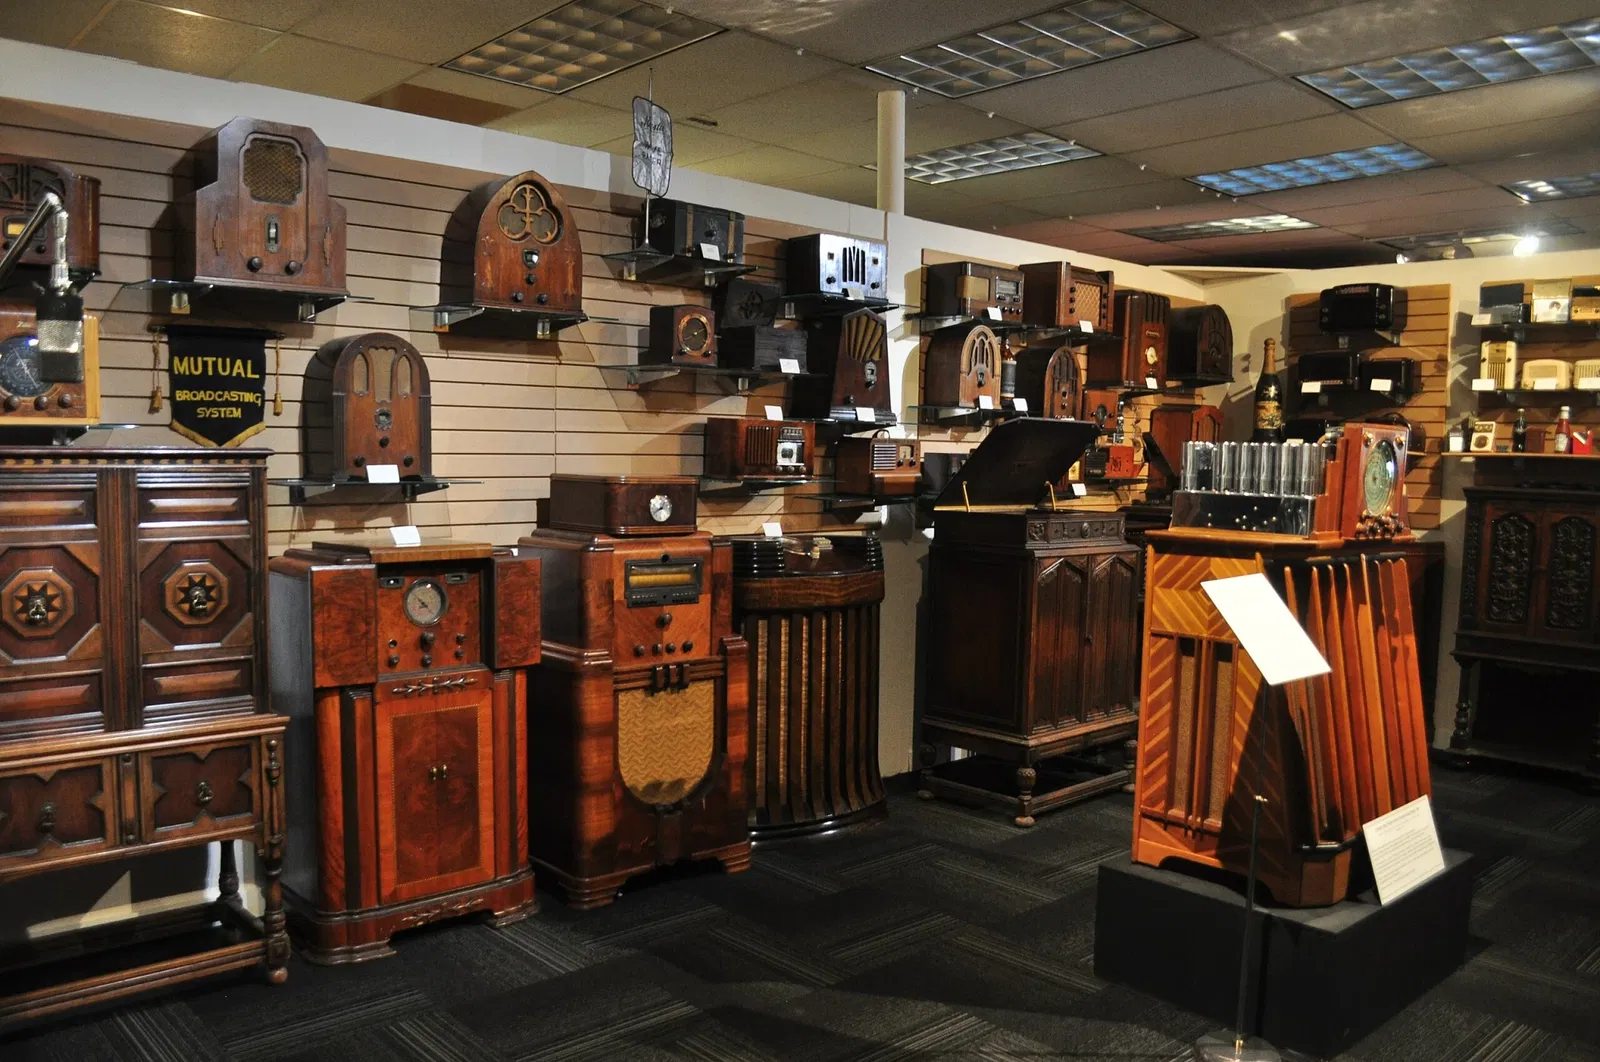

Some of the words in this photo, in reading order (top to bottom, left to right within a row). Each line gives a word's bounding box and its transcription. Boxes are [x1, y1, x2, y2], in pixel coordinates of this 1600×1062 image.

[173, 356, 260, 378] MUTUAL
[175, 389, 262, 407] BROADCASTING
[196, 407, 241, 419] SYSTEM
